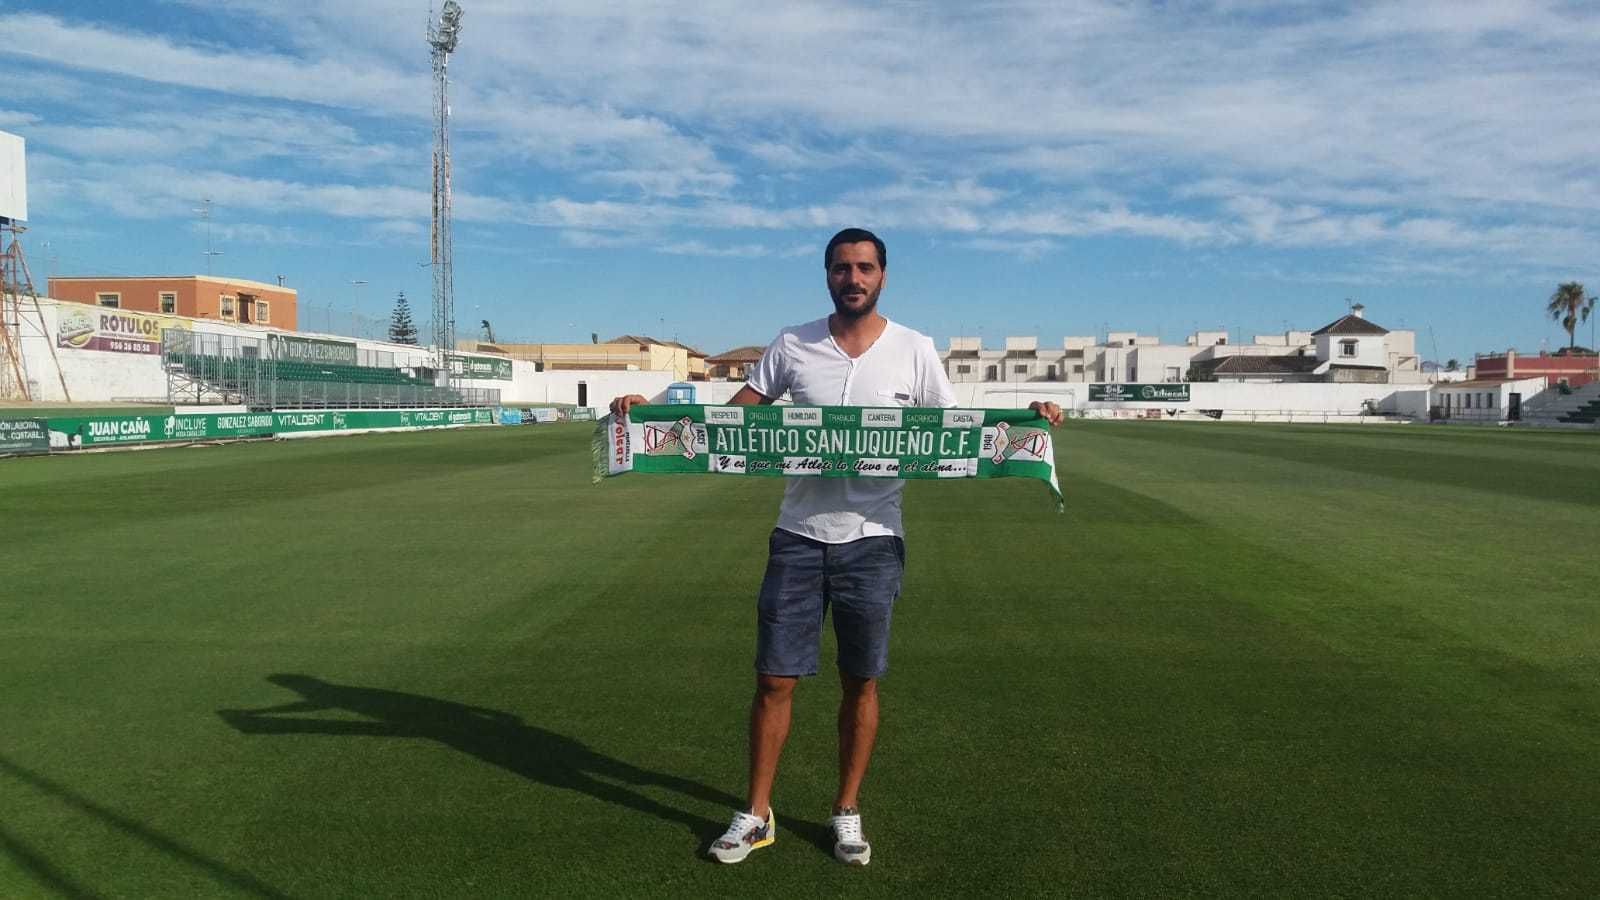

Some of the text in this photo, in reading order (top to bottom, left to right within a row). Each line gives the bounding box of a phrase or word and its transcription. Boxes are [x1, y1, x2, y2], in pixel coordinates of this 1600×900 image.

[278, 414, 325, 427] VITALDENT
[415, 412, 444, 422] VITALDENT
[711, 411, 739, 420] RESPETO
[787, 411, 817, 421] HUMILDAD
[867, 413, 897, 422] CANTERA
[952, 415, 975, 423] CASTA
[88, 416, 151, 436] JUAN CAÑA
[175, 418, 207, 431] INCLUYE
[716, 422, 972, 457] ATLÉTICO SANLUQUEÑO C.F.
[719, 455, 730, 470] Y
[733, 460, 746, 469] es
[750, 460, 771, 472] que
[775, 458, 791, 470] mi
[795, 457, 833, 471] Atleti
[836, 460, 848, 470] lo
[853, 460, 882, 472] llevo
[886, 464, 900, 472] en
[904, 460, 918, 472] el
